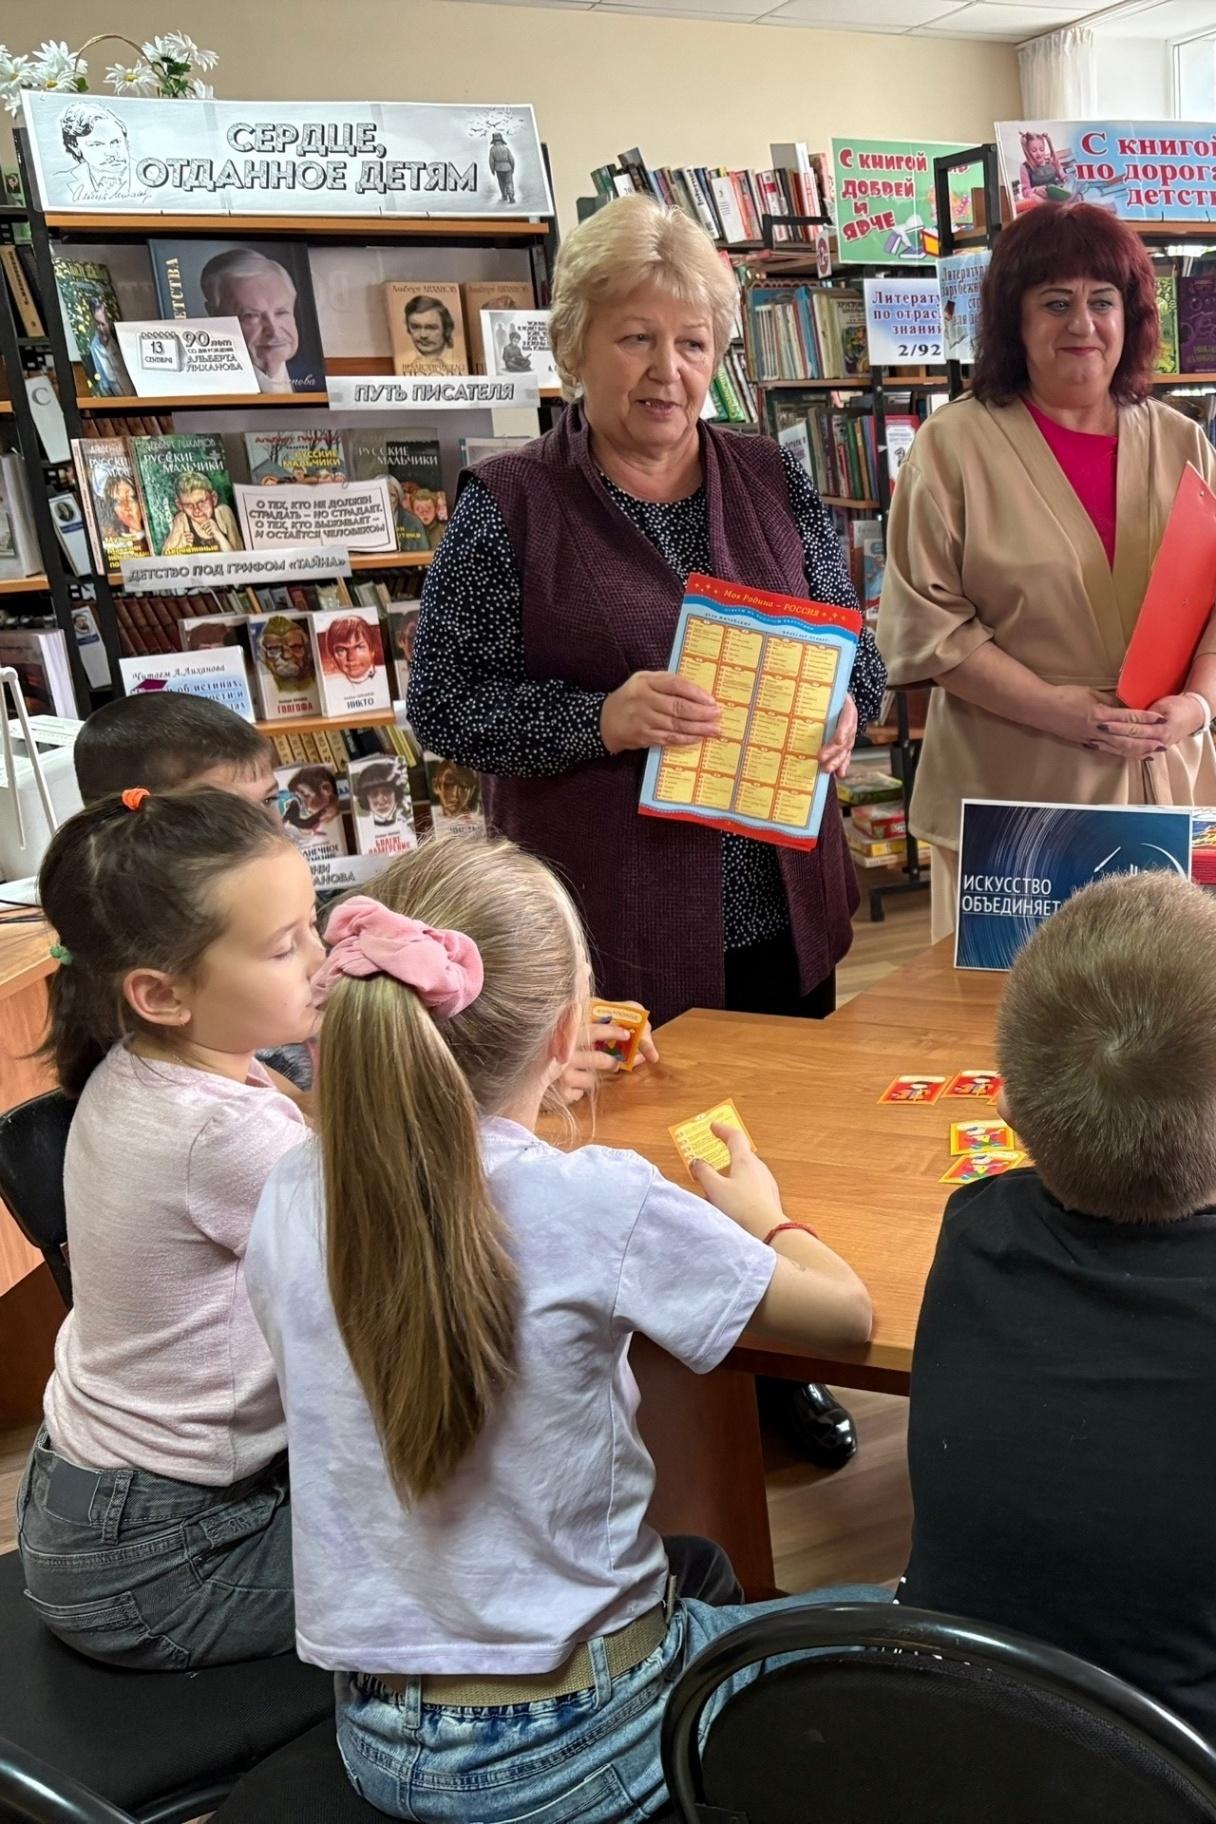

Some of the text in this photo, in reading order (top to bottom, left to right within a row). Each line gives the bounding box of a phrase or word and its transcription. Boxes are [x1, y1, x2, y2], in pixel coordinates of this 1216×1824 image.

[226, 122, 387, 158] СЕРДЦЕ,
[1081, 132, 1107, 155] С
[839, 149, 852, 168] С
[136, 158, 477, 194] ОТДАННОЕ ДЕТЯМ
[1075, 164, 1114, 181] по
[165, 257, 187, 320] ЕТСТВА
[872, 291, 940, 308] Литерату
[873, 310, 940, 322] по отрас
[183, 331, 210, 347] 90
[150, 341, 163, 354] 13
[898, 344, 941, 357] 2/92
[187, 354, 237, 364] АЛЬБЕРТА
[186, 363, 243, 372] ЛИХАНОВА
[354, 383, 515, 401] ПУТЬ ПИСАТЕЛЯ
[144, 452, 194, 464] РУССКИЕ
[358, 447, 409, 457] РУССКИЕ
[282, 458, 341, 468] МАЛЬЧИКИ
[377, 455, 438, 466] МАЛЬЧИКИ
[162, 462, 224, 473] МАЛЬЧИКИ
[250, 510, 301, 520] СТРАДАТЬ
[128, 555, 346, 582] ДЕТСТВО ПОД ГРИФОМ «ТАЙНА»
[277, 702, 313, 714] ГОЛГОФА
[347, 698, 374, 709] НИКТО
[314, 872, 355, 886] АНОВА
[963, 875, 1052, 894] ИСКУССТВО
